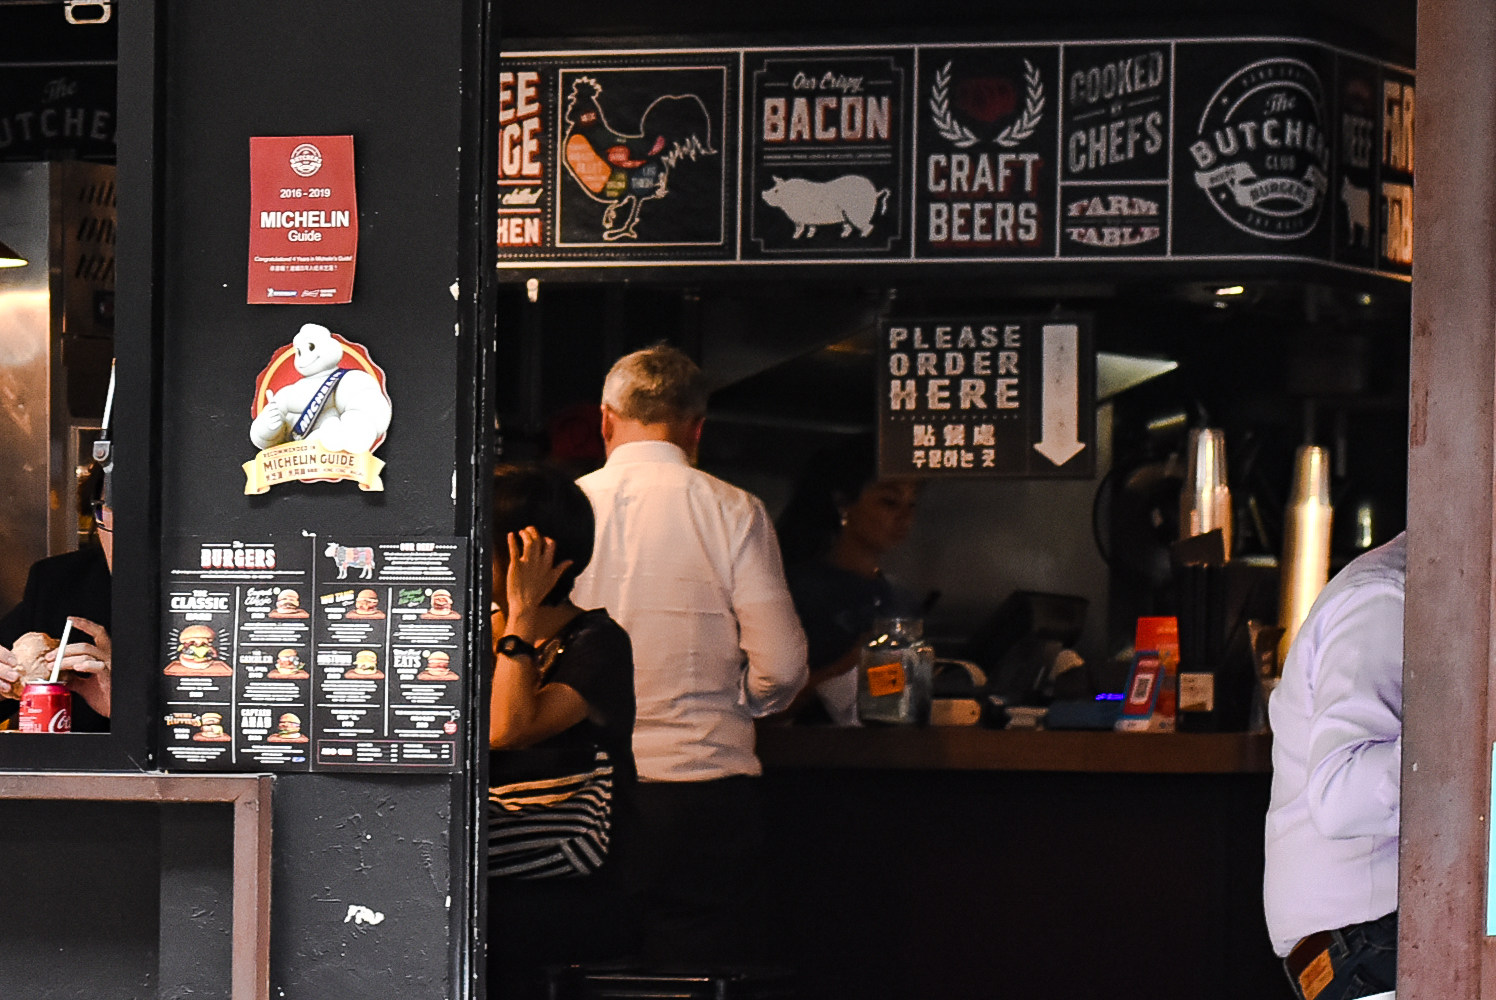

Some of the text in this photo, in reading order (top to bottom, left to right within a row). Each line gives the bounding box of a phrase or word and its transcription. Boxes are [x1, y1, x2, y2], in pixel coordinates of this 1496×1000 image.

[793, 72, 816, 90] Our
[1069, 51, 1164, 104] COOKED
[763, 96, 891, 142] BACON
[1068, 111, 1164, 174] CHEFS
[928, 153, 1042, 194] CRAFT
[279, 188, 302, 199] 2016
[308, 188, 332, 199] 2019
[1068, 195, 1160, 217] FARM
[260, 210, 350, 229] MICHELIN
[928, 202, 1039, 243] BEERS
[287, 230, 323, 242] Guide
[1065, 227, 1161, 248] TABLE
[889, 324, 1021, 349] PLEASE
[889, 351, 1019, 376] ORDER
[298, 370, 343, 434] MICHELIN
[889, 378, 1021, 410] HERE
[263, 453, 356, 472] MICHELIN GUIDE
[200, 548, 276, 570] BURGERS
[170, 597, 229, 610] CLASSIC
[393, 655, 422, 668] EATS
